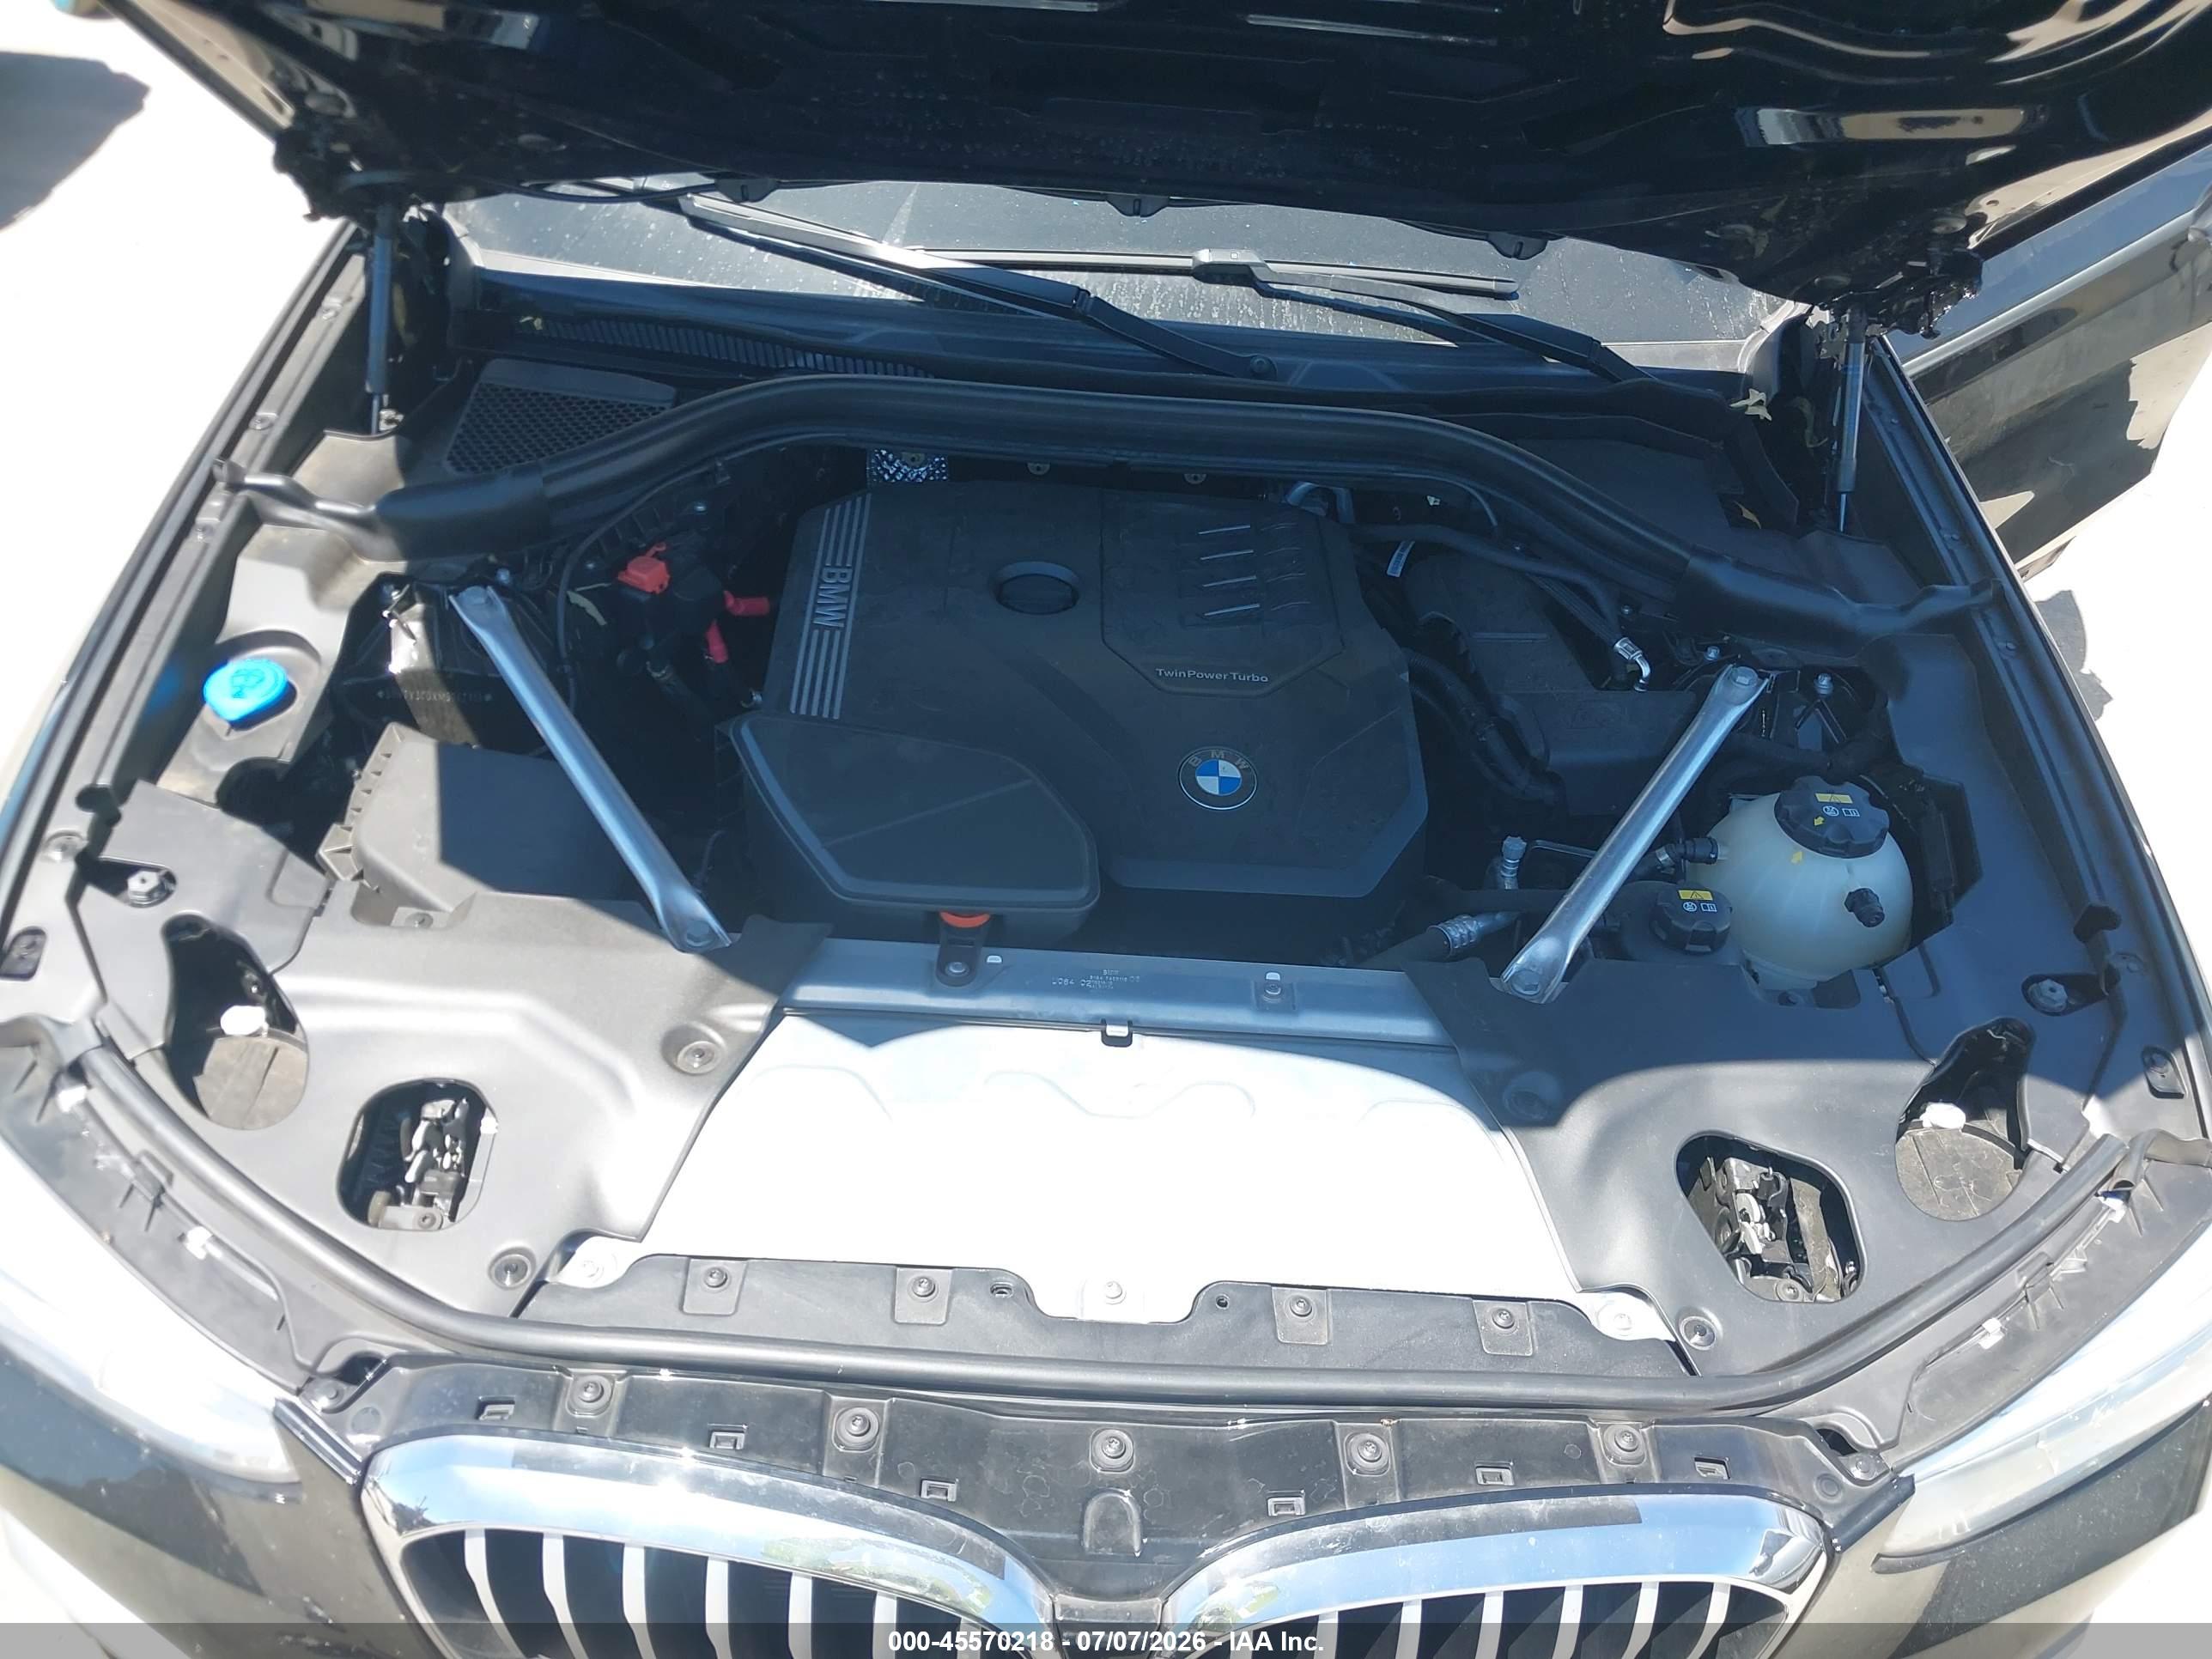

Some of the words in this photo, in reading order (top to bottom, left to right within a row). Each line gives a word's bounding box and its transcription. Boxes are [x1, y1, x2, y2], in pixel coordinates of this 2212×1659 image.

[813, 568, 853, 628] BMW
[1156, 668, 1228, 680] TwinPower
[1230, 672, 1268, 682] Turbo
[1188, 750, 1249, 769] BMW
